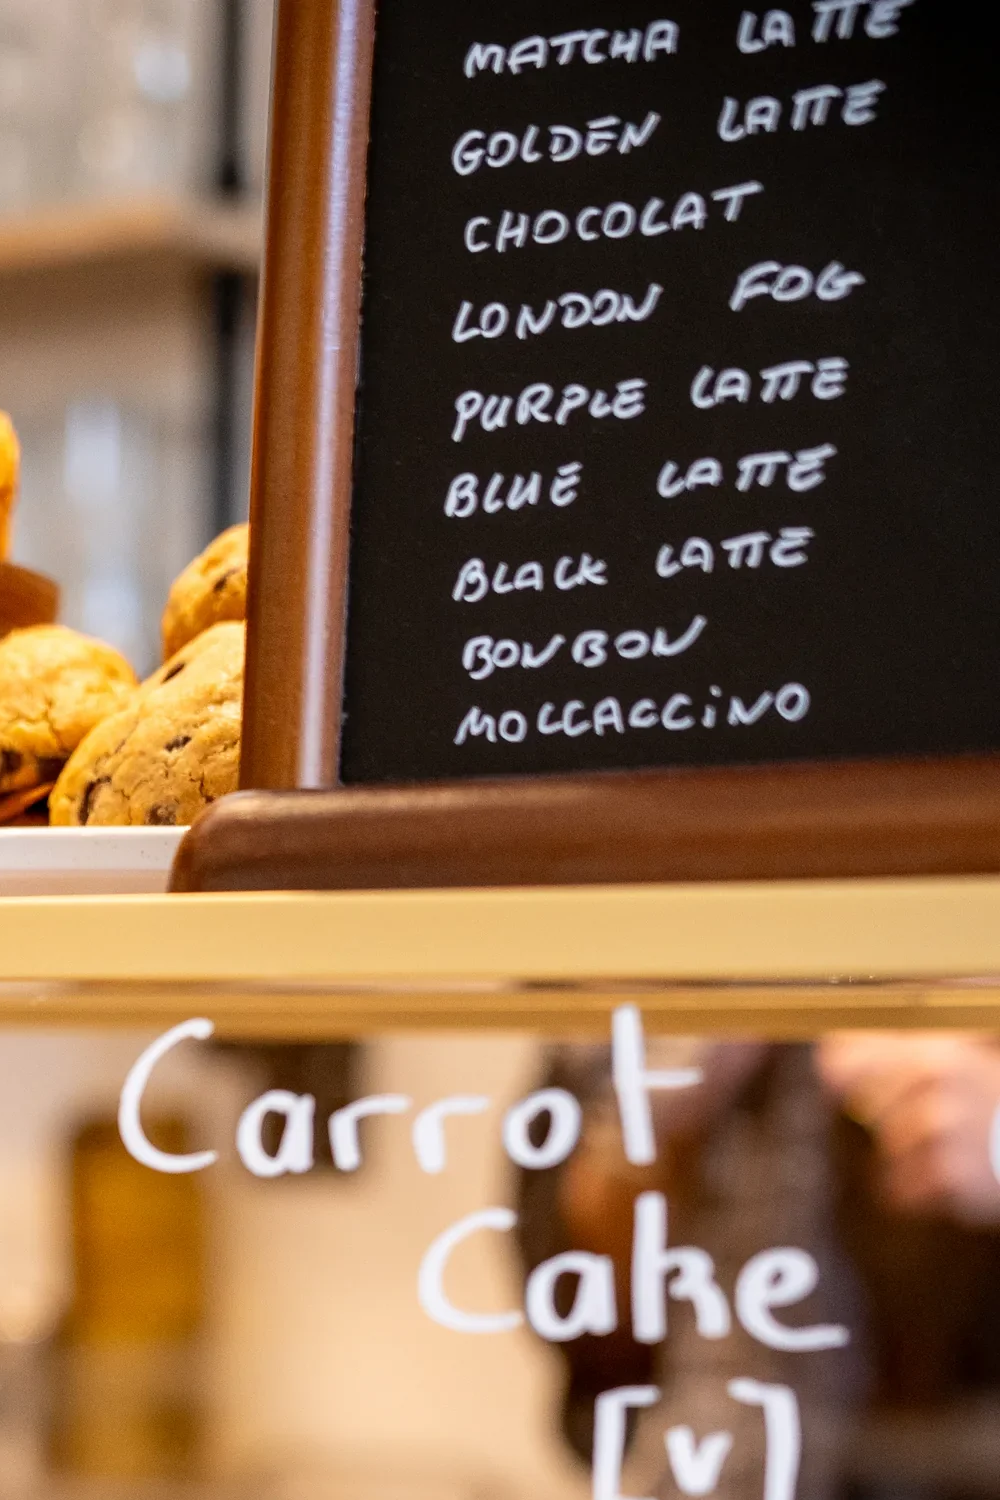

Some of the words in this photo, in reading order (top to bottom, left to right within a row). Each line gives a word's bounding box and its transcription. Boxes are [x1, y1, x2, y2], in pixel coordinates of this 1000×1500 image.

[463, 19, 678, 79] MATCHA
[737, 0, 911, 54] LATTE
[451, 112, 661, 177] GOLDEN
[718, 80, 886, 142] LATTE
[464, 181, 764, 254] CHOCOLAT
[451, 282, 663, 344] LONDON
[729, 260, 866, 312] FOG
[450, 377, 647, 444] PURPLE
[689, 356, 849, 410] LATTE
[443, 461, 583, 519] BLUE
[655, 443, 837, 499] LATTE
[450, 553, 609, 604] BLACK
[655, 526, 815, 579] LATTE
[461, 615, 707, 681] BONBON
[119, 1003, 703, 1177] Carrot
[418, 1192, 848, 1350] Cake
